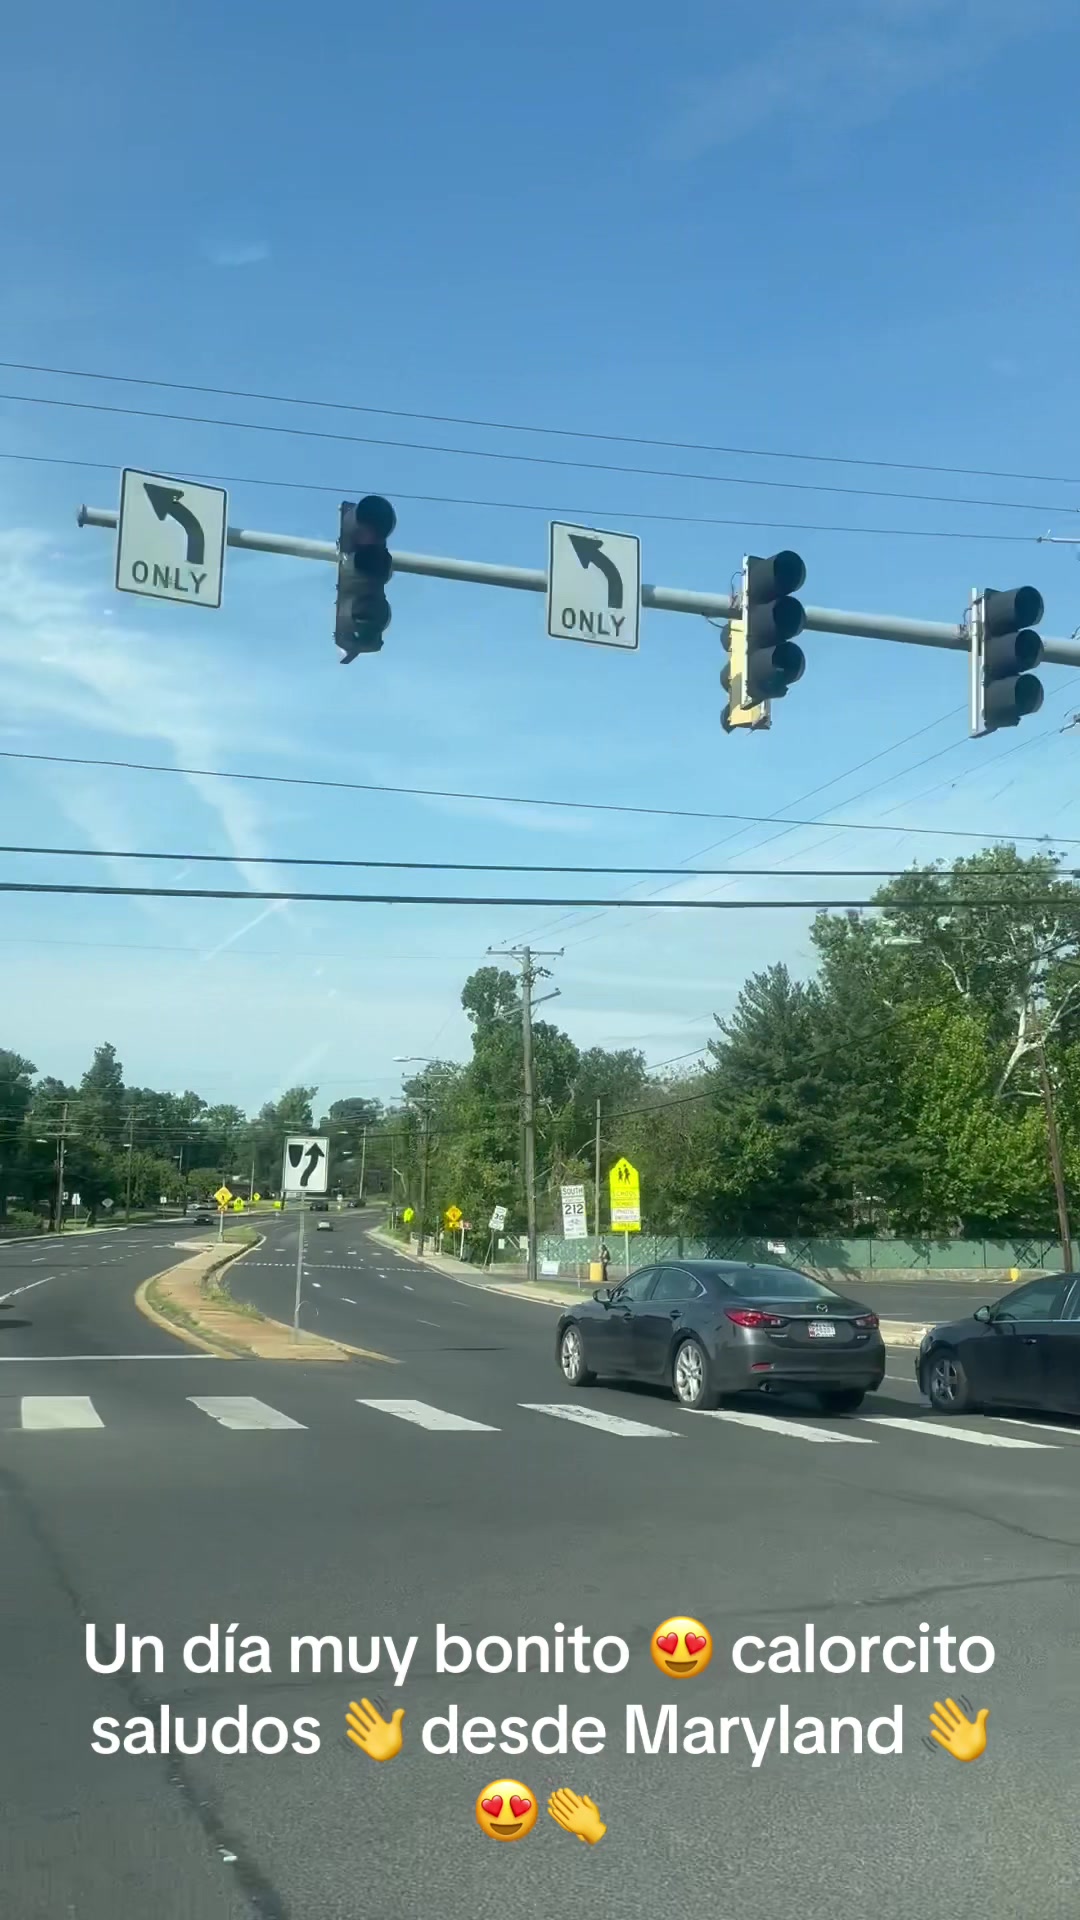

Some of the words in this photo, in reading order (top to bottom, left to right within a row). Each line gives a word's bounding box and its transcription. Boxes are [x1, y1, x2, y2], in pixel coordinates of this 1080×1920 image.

[131, 560, 208, 594] ONLY
[561, 607, 626, 637] ONLY
[562, 1187, 583, 1196] SOUTH
[564, 1203, 584, 1215] 212
